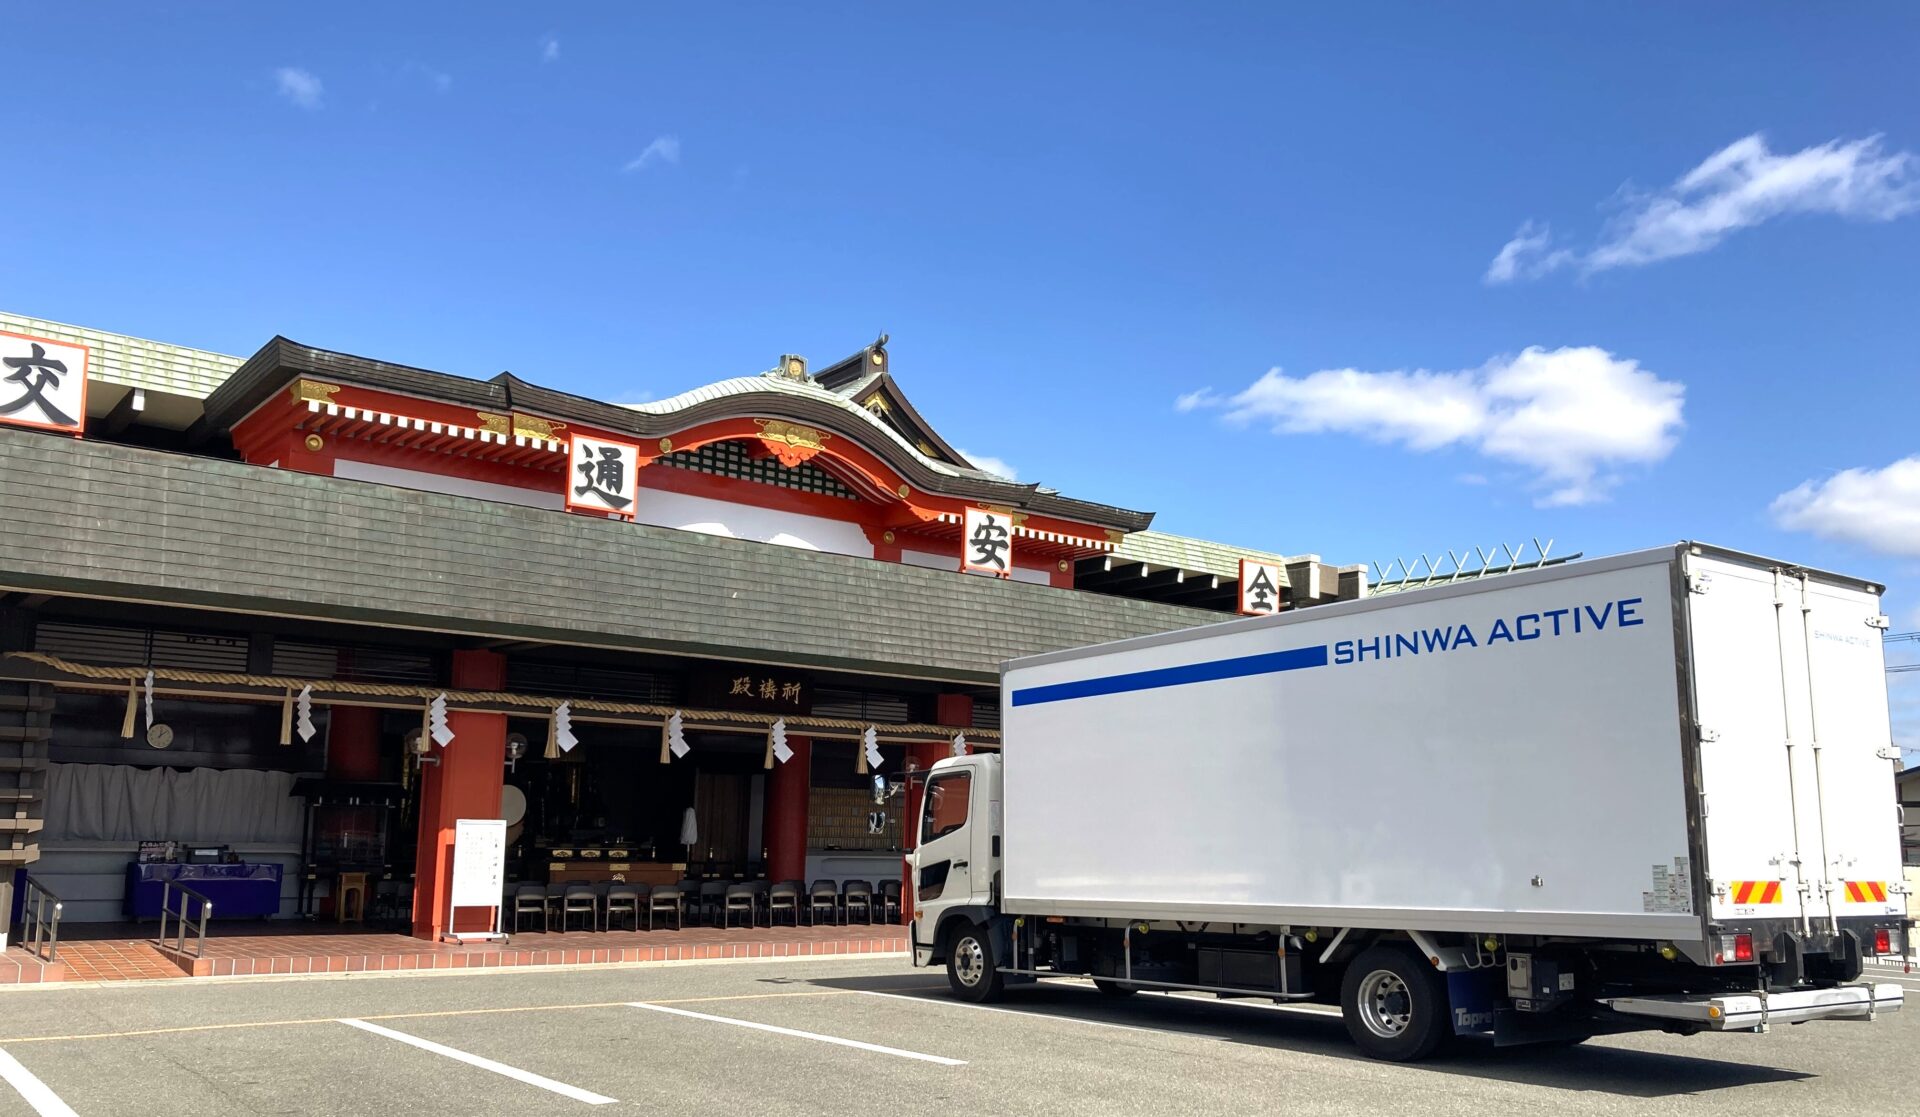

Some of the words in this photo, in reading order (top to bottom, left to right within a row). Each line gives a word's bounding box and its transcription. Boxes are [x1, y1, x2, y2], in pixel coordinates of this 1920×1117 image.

[0, 343, 78, 425] 交
[575, 443, 632, 508] 通
[969, 515, 1009, 569] 安
[1245, 566, 1277, 610] 全
[1334, 624, 1478, 665] SHINWA
[1487, 597, 1644, 645] ACTIVE
